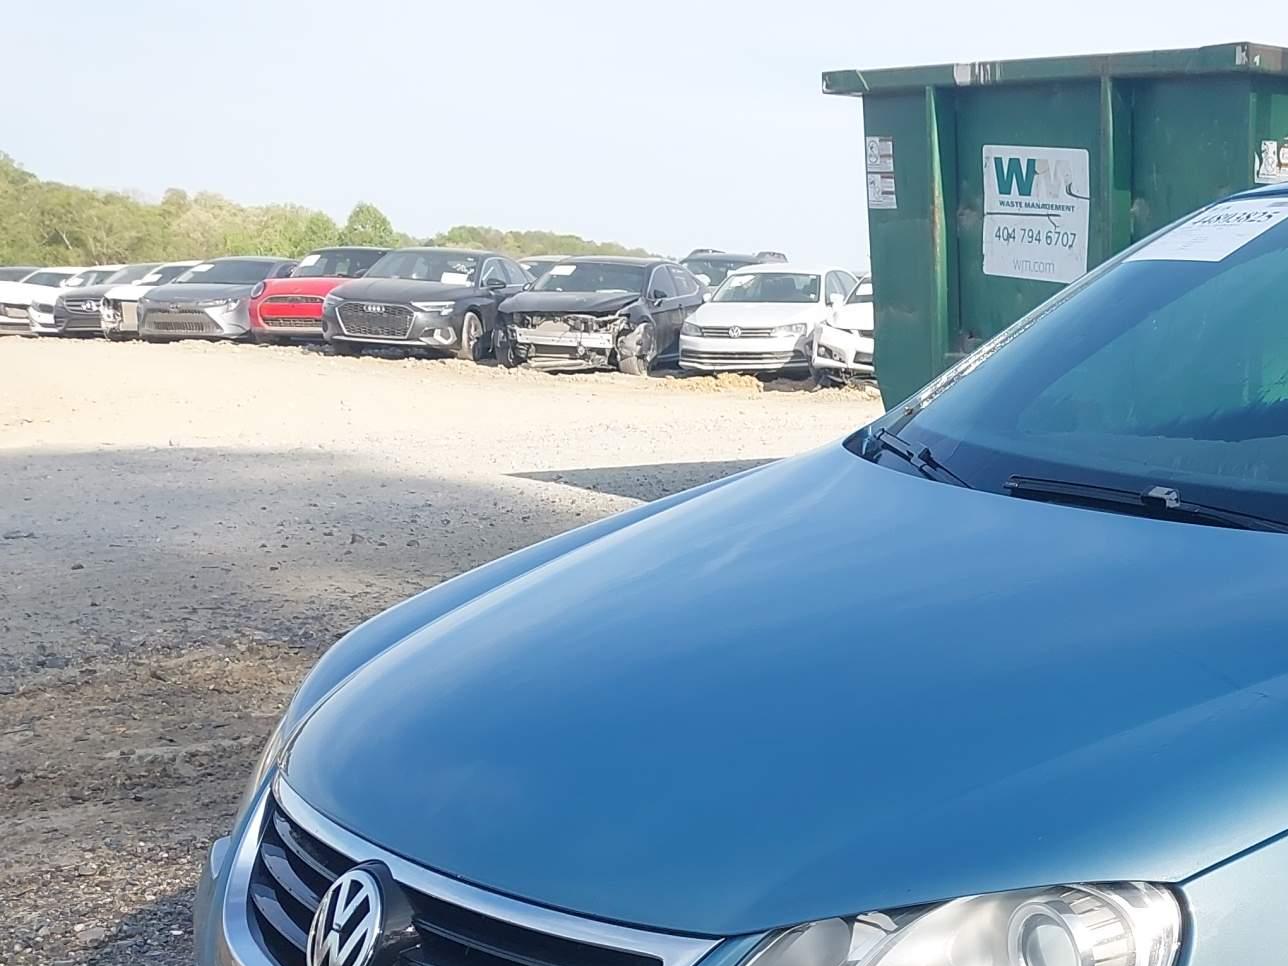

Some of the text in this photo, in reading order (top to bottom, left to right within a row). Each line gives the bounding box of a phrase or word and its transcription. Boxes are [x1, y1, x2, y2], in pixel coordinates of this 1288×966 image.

[998, 199, 1076, 213] WASTE MANAGEMENT
[994, 226, 1077, 249] 404 794 6707
[1012, 259, 1056, 274] wm.com
